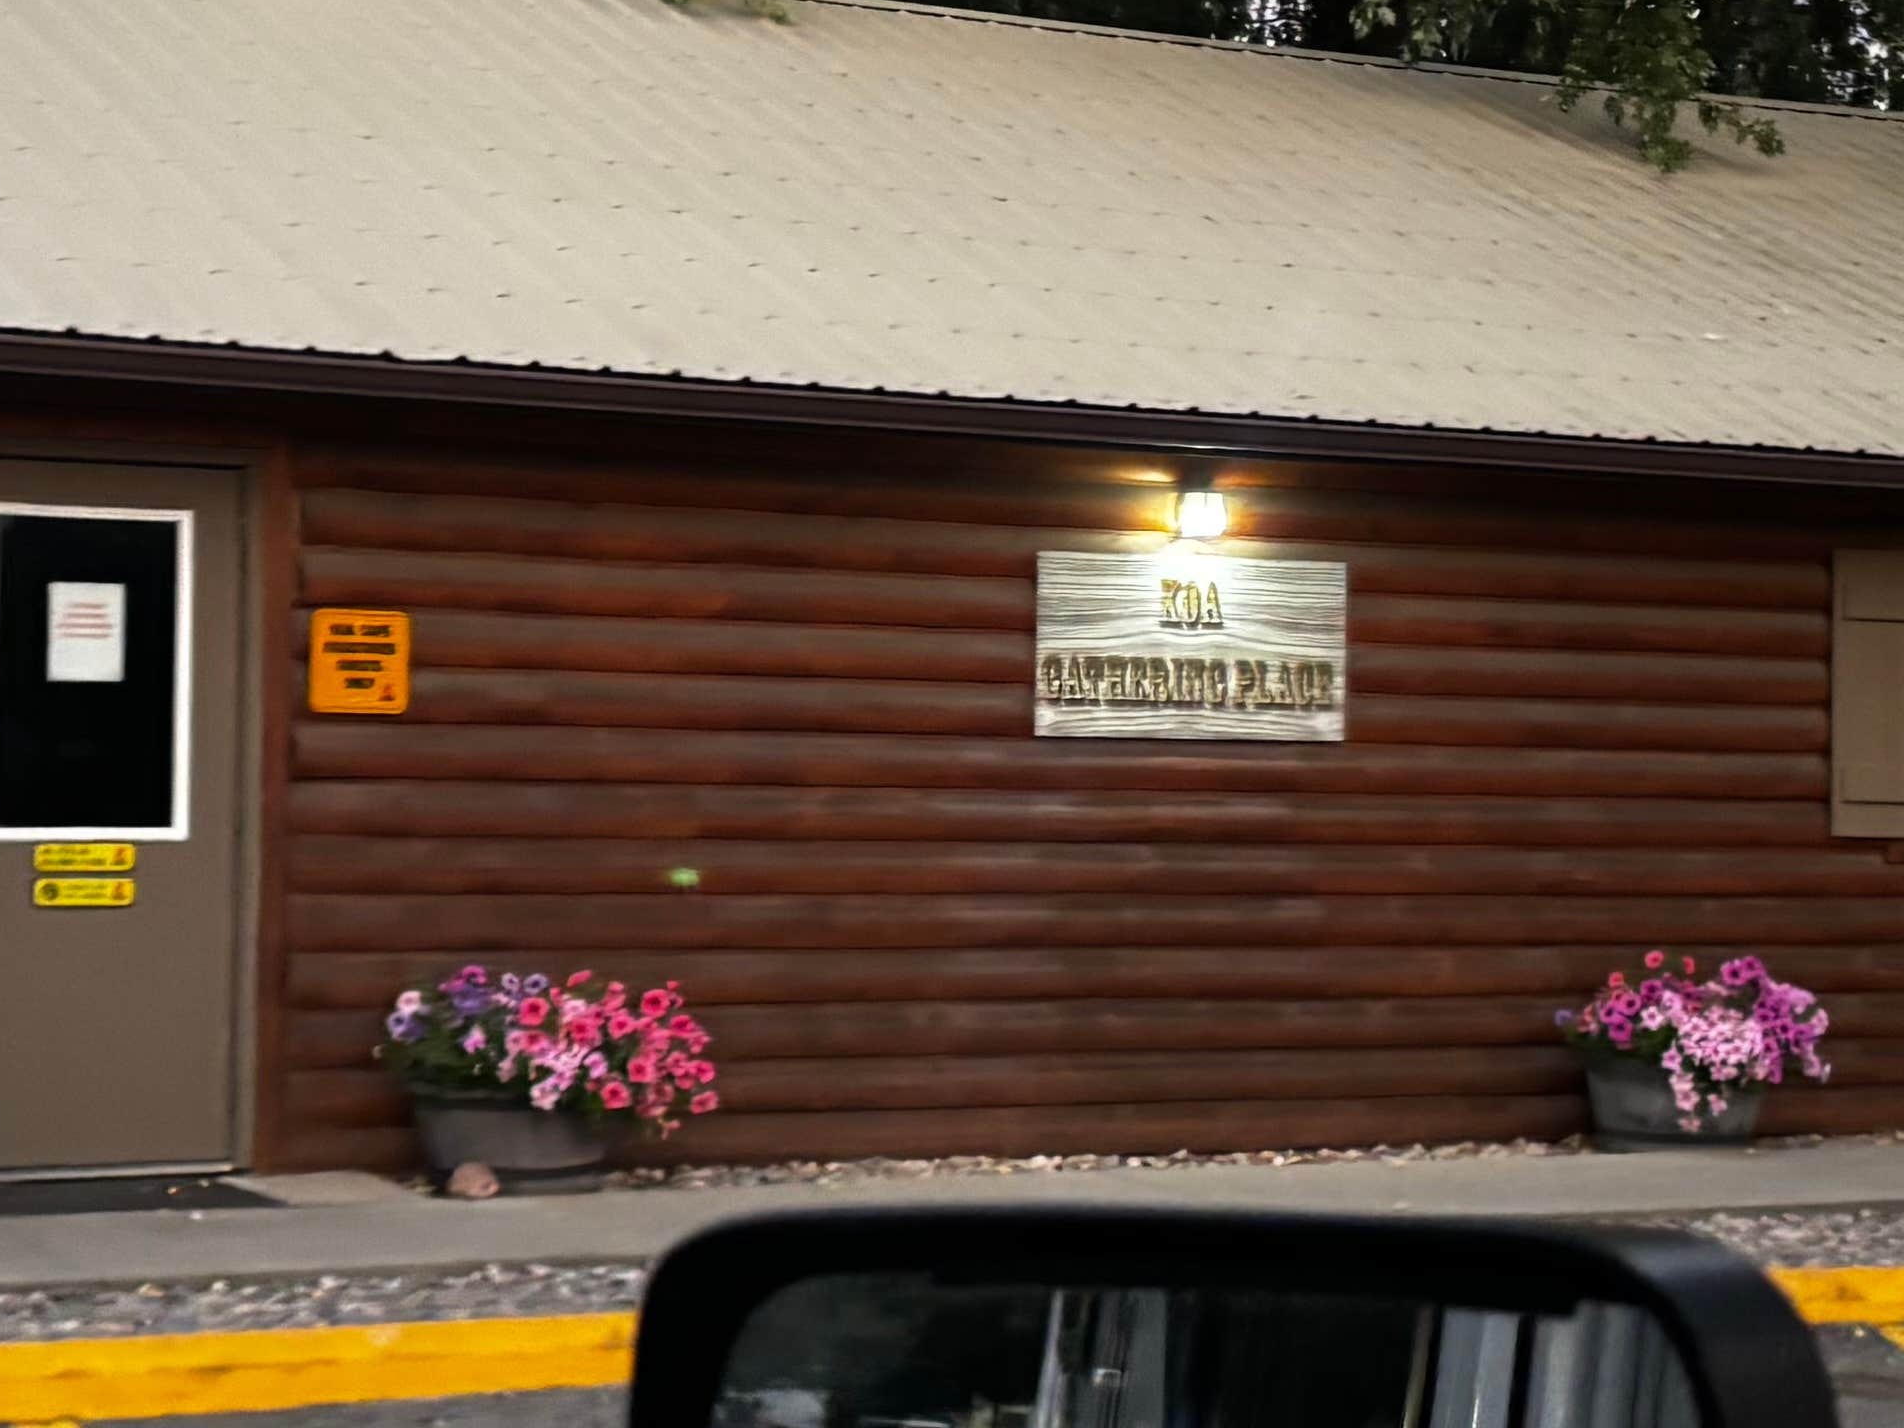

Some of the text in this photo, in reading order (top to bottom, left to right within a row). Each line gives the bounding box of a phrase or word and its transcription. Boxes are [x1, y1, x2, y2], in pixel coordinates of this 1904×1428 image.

[1160, 579, 1224, 627] KOA
[1041, 655, 1335, 706] GATHERING PLACE
